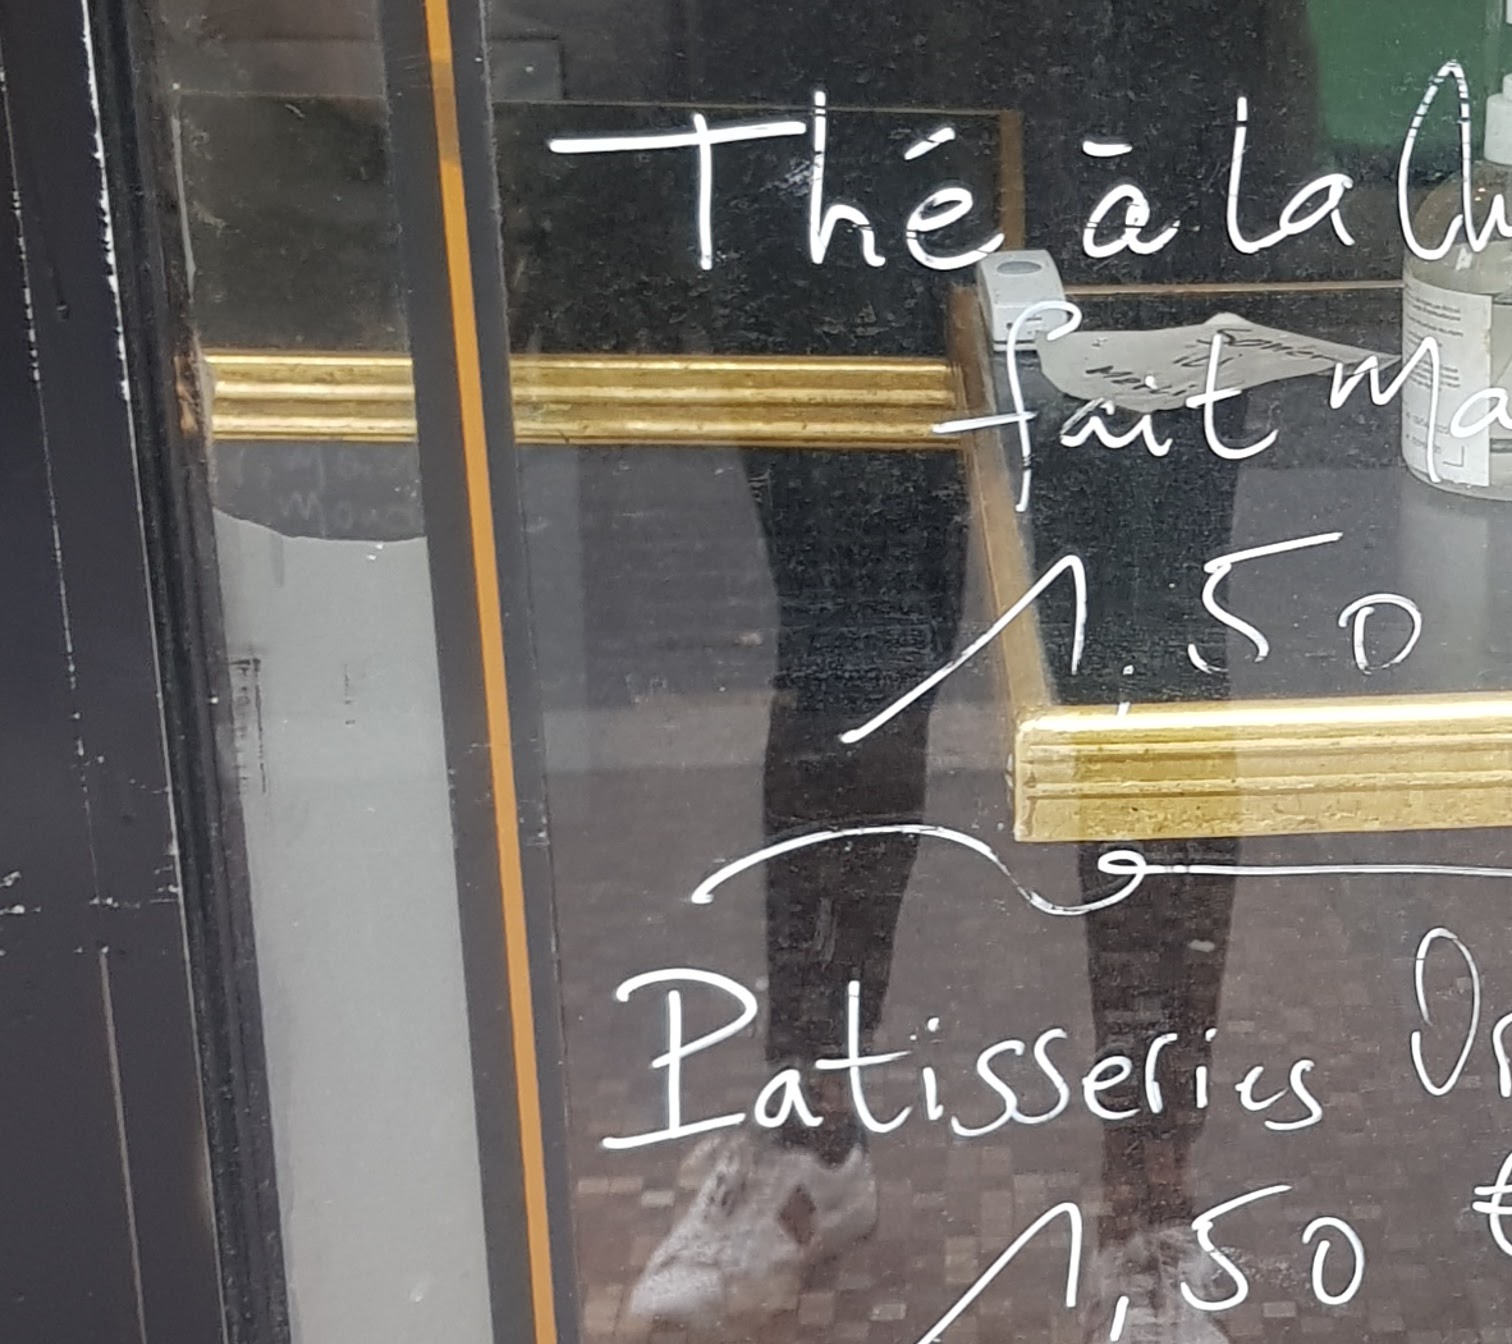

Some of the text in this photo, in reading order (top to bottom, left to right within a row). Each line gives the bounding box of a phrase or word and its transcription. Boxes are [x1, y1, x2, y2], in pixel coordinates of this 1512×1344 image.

[548, 90, 1004, 272] Thé
[932, 300, 1279, 514] fait
[600, 966, 1326, 1150] Patisseries
